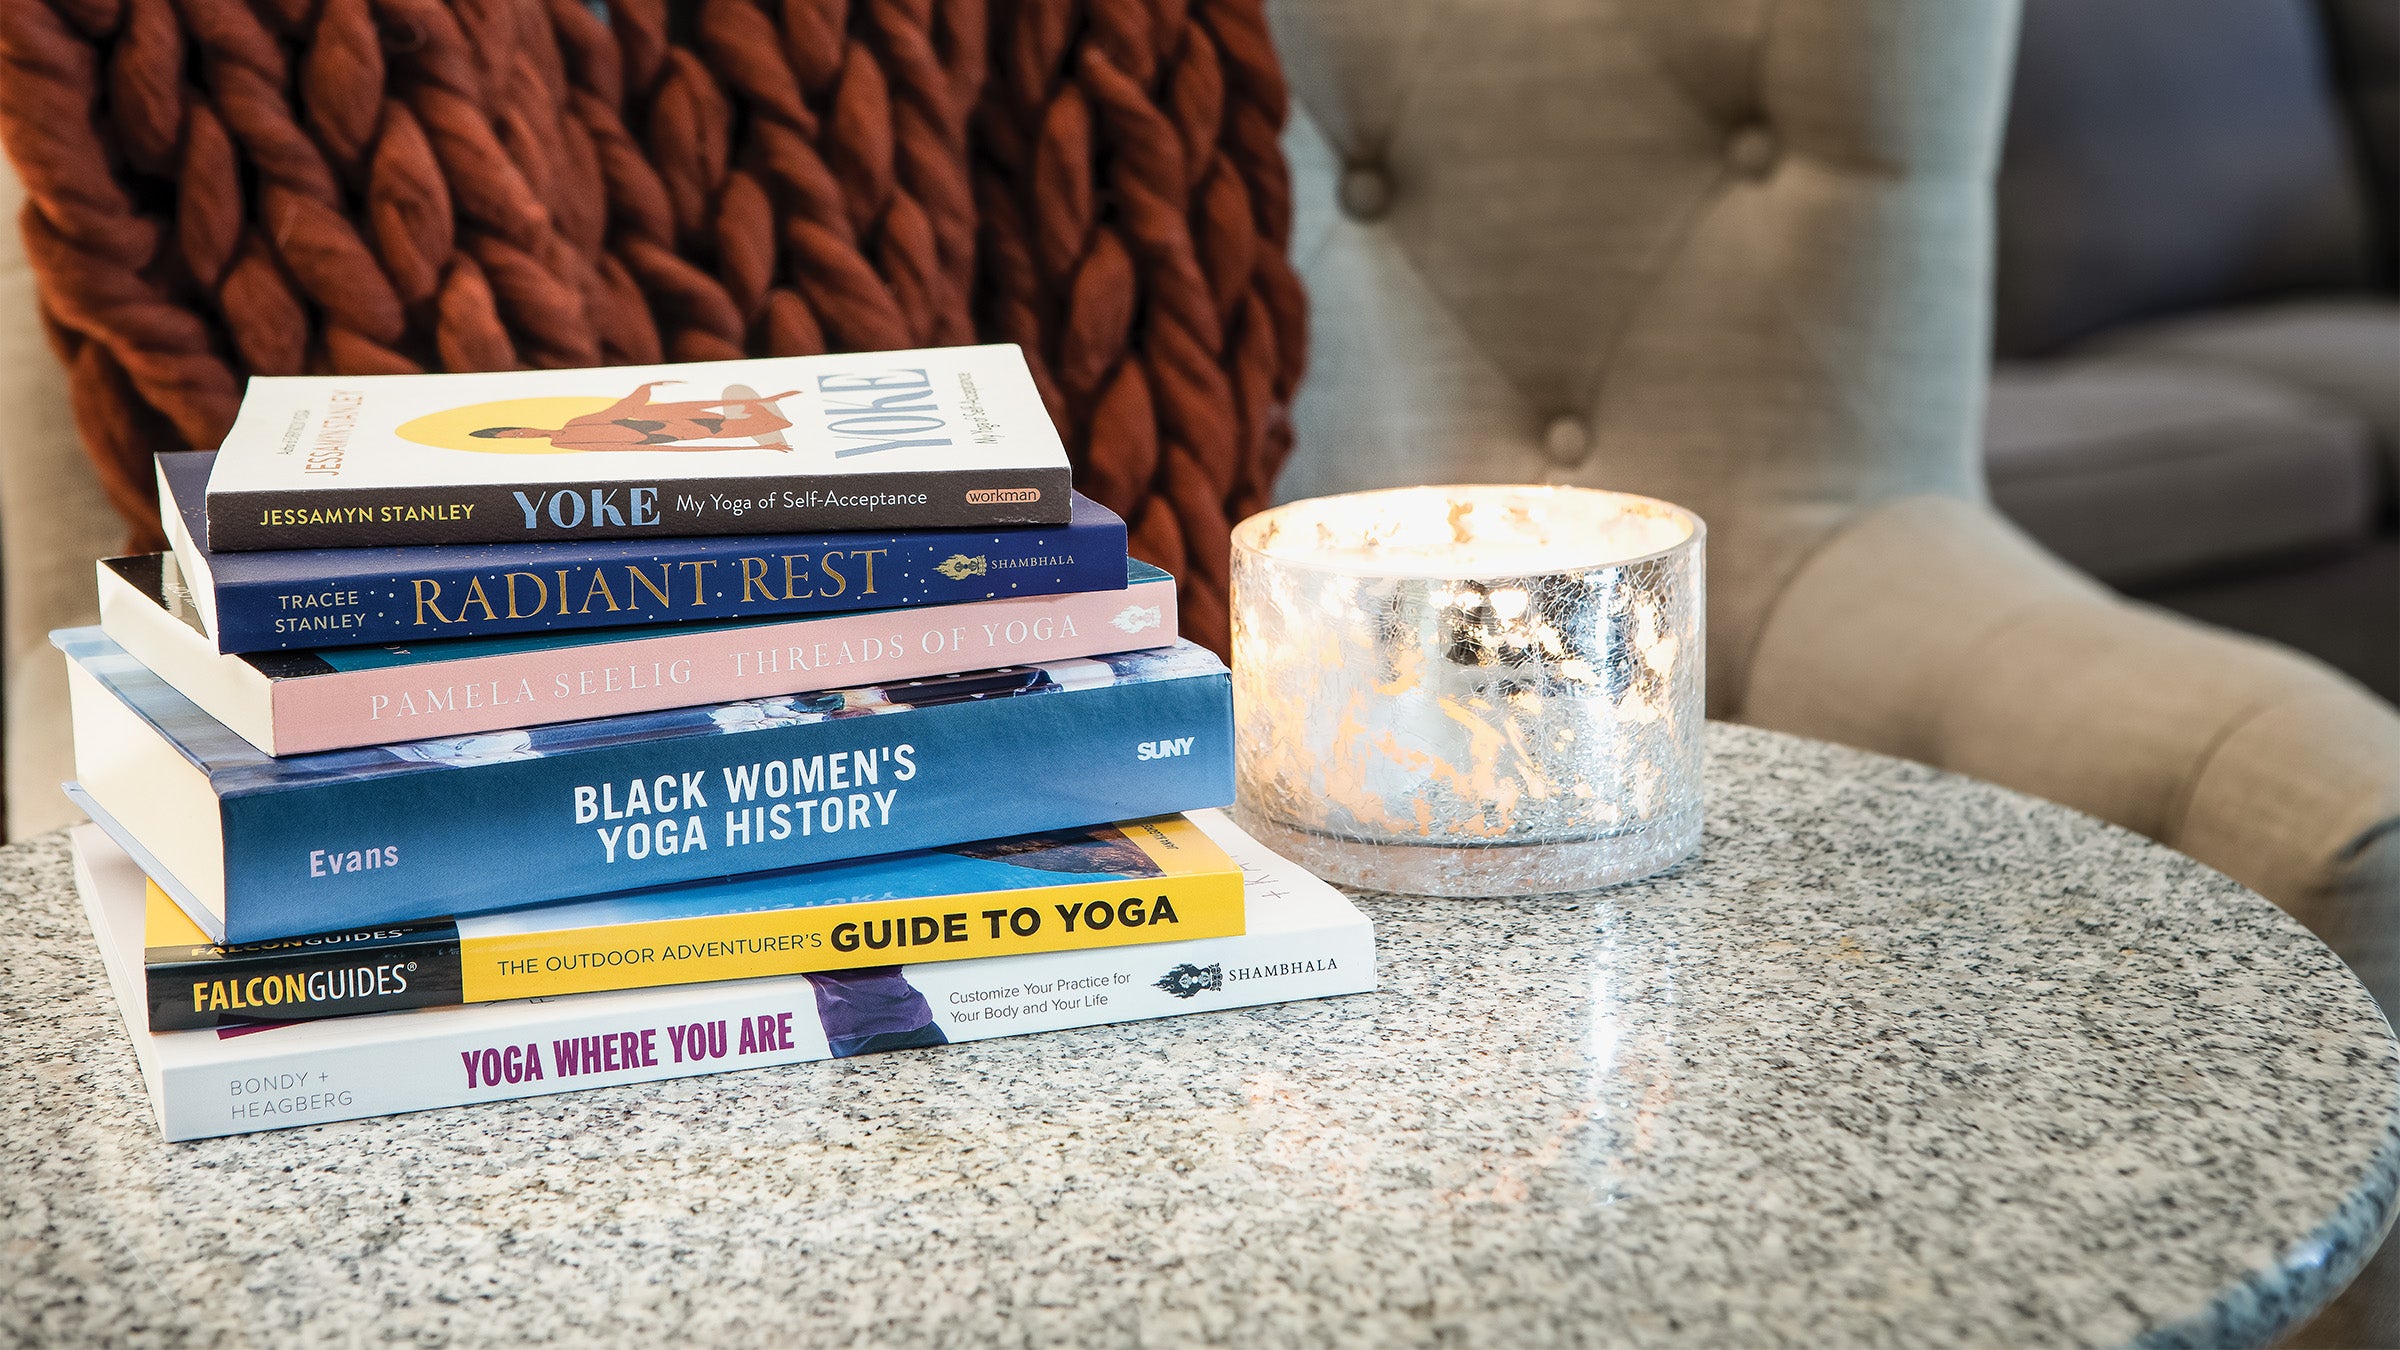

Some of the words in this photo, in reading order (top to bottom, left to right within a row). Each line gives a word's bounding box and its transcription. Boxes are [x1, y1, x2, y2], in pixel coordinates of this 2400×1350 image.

[817, 368, 953, 459] YOKE
[512, 487, 661, 529] YOKE
[676, 494, 705, 517] My
[710, 493, 752, 516] Yoga
[758, 491, 777, 509] of
[783, 489, 928, 512] Self-Acceptance
[968, 488, 1038, 503] workman
[260, 506, 374, 526] JESSAMYN
[381, 503, 475, 523] STANLEY
[991, 554, 1075, 569] SHAMBHALA
[278, 590, 359, 610] TRACEE
[411, 559, 717, 626] RADIANT
[739, 549, 888, 602] REST
[275, 613, 366, 633] STANLEY
[729, 634, 904, 677] THREADS
[921, 626, 967, 654] OF
[982, 615, 1079, 647] YOGA
[370, 678, 536, 721] PAMELA
[553, 659, 692, 699] SEELIG
[1137, 736, 1195, 761] SUNY
[574, 770, 708, 824] BLACK
[723, 743, 917, 803] WOMEN'S
[597, 815, 708, 864] YOGA
[726, 789, 898, 847] HISTORY
[310, 845, 399, 878] Evans
[498, 958, 539, 976] THE
[546, 948, 655, 972] OUTDOOR
[830, 913, 968, 953] GUIDE
[982, 906, 1043, 939] TO
[1054, 895, 1179, 933] YOGA
[1229, 957, 1338, 982] SHAMBHALA
[950, 986, 1020, 1004] Customize
[1023, 982, 1053, 996] Your
[1057, 975, 1110, 992] Practice
[1113, 972, 1131, 985] for
[950, 1009, 981, 1023] Your
[984, 1004, 1019, 1019] Body
[1023, 1000, 1048, 1014] and
[1052, 998, 1081, 1011] Your
[1085, 993, 1109, 1008] Life
[461, 1043, 544, 1089] YOGA
[553, 1029, 658, 1078] WHERE
[666, 1020, 727, 1063] YOU
[739, 1012, 795, 1056] ARE
[230, 1070, 309, 1096] BONDY
[319, 1071, 329, 1082] +
[231, 1089, 353, 1120] HEAGBERG
